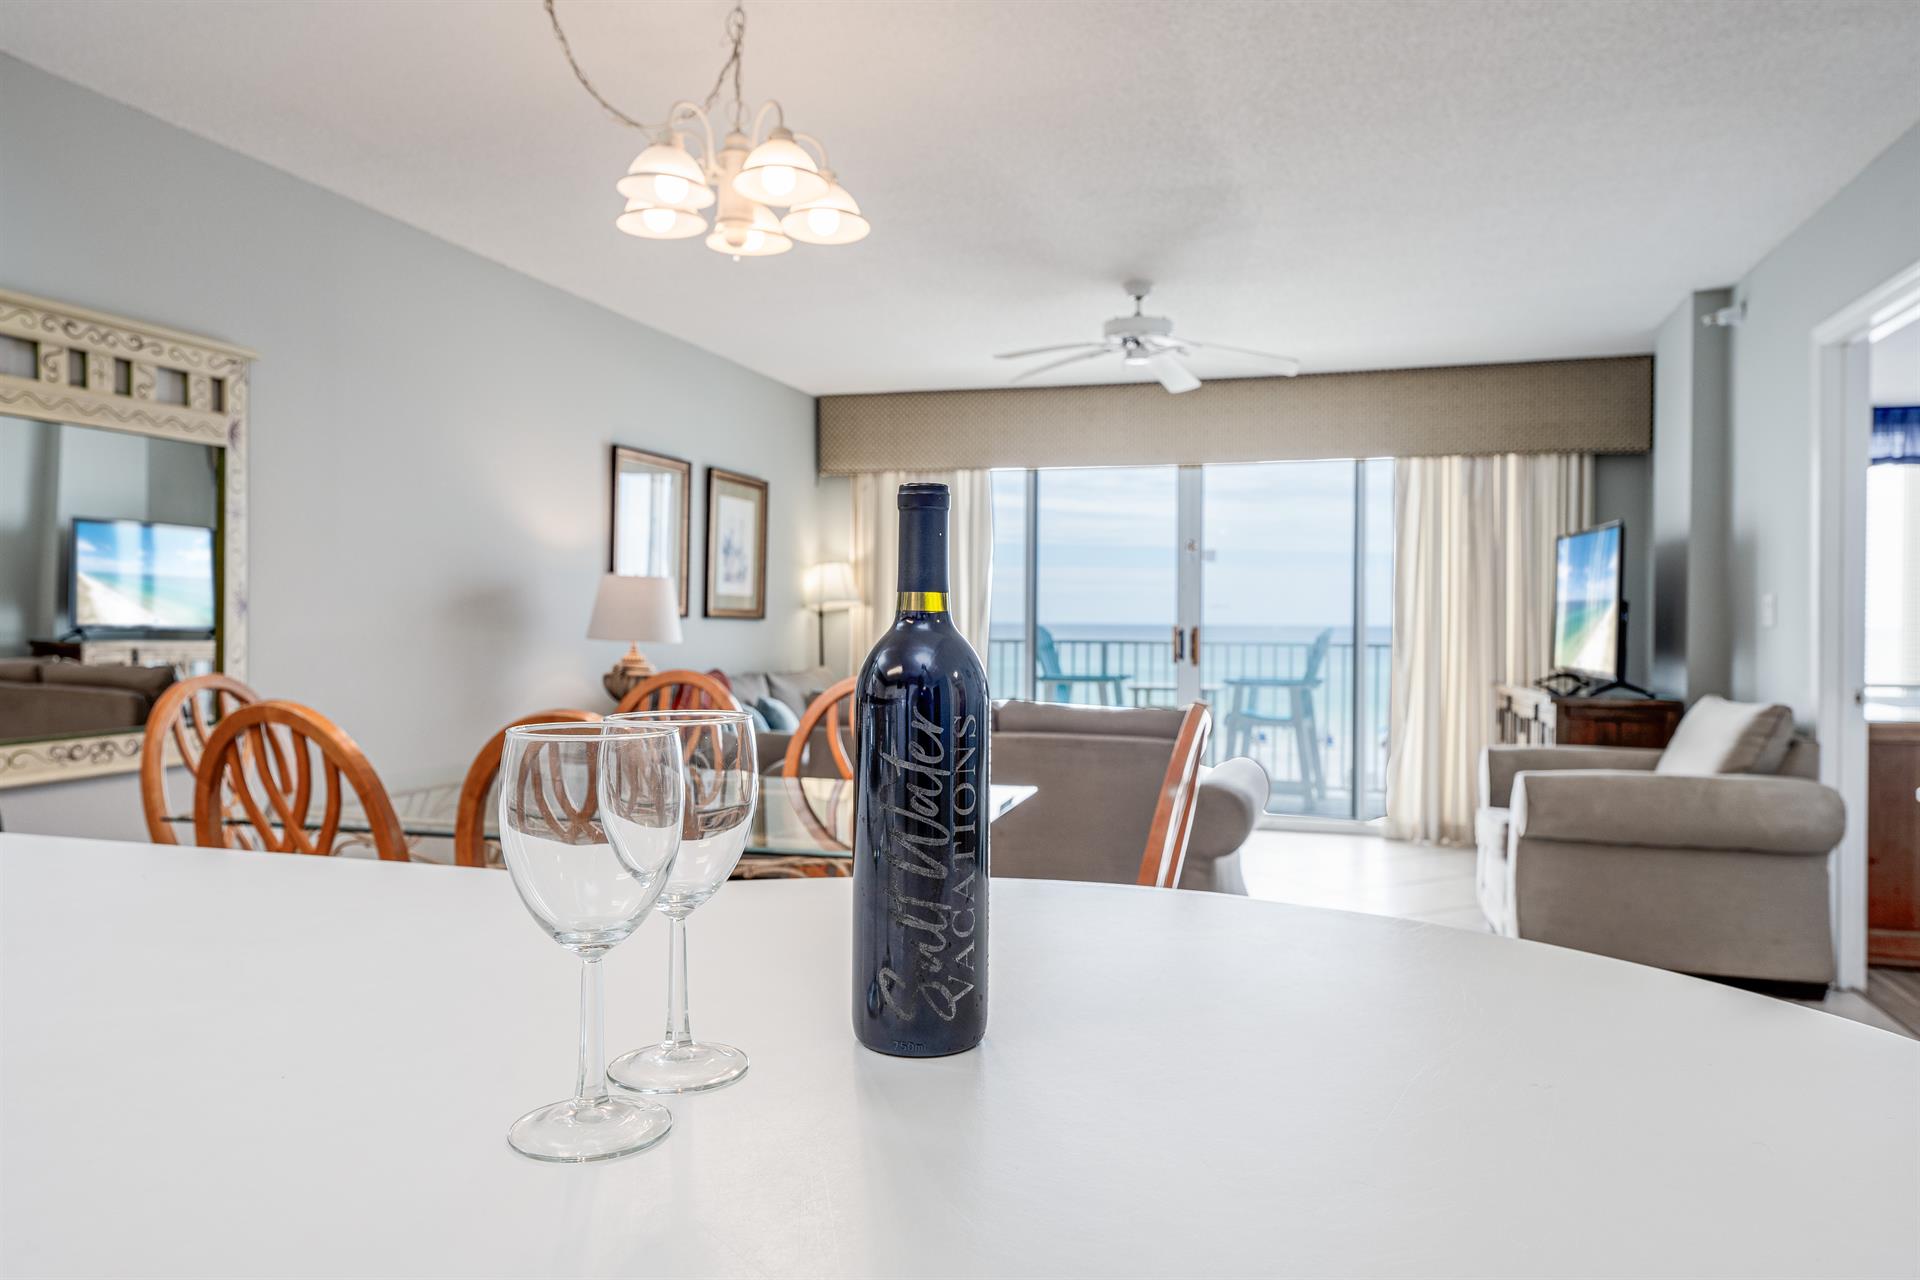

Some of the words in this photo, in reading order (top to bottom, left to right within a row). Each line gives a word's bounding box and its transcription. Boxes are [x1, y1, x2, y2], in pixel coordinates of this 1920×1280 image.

[879, 705, 951, 881] Water
[950, 713, 978, 1001] VACATIONS
[878, 882, 956, 1021] Salt
